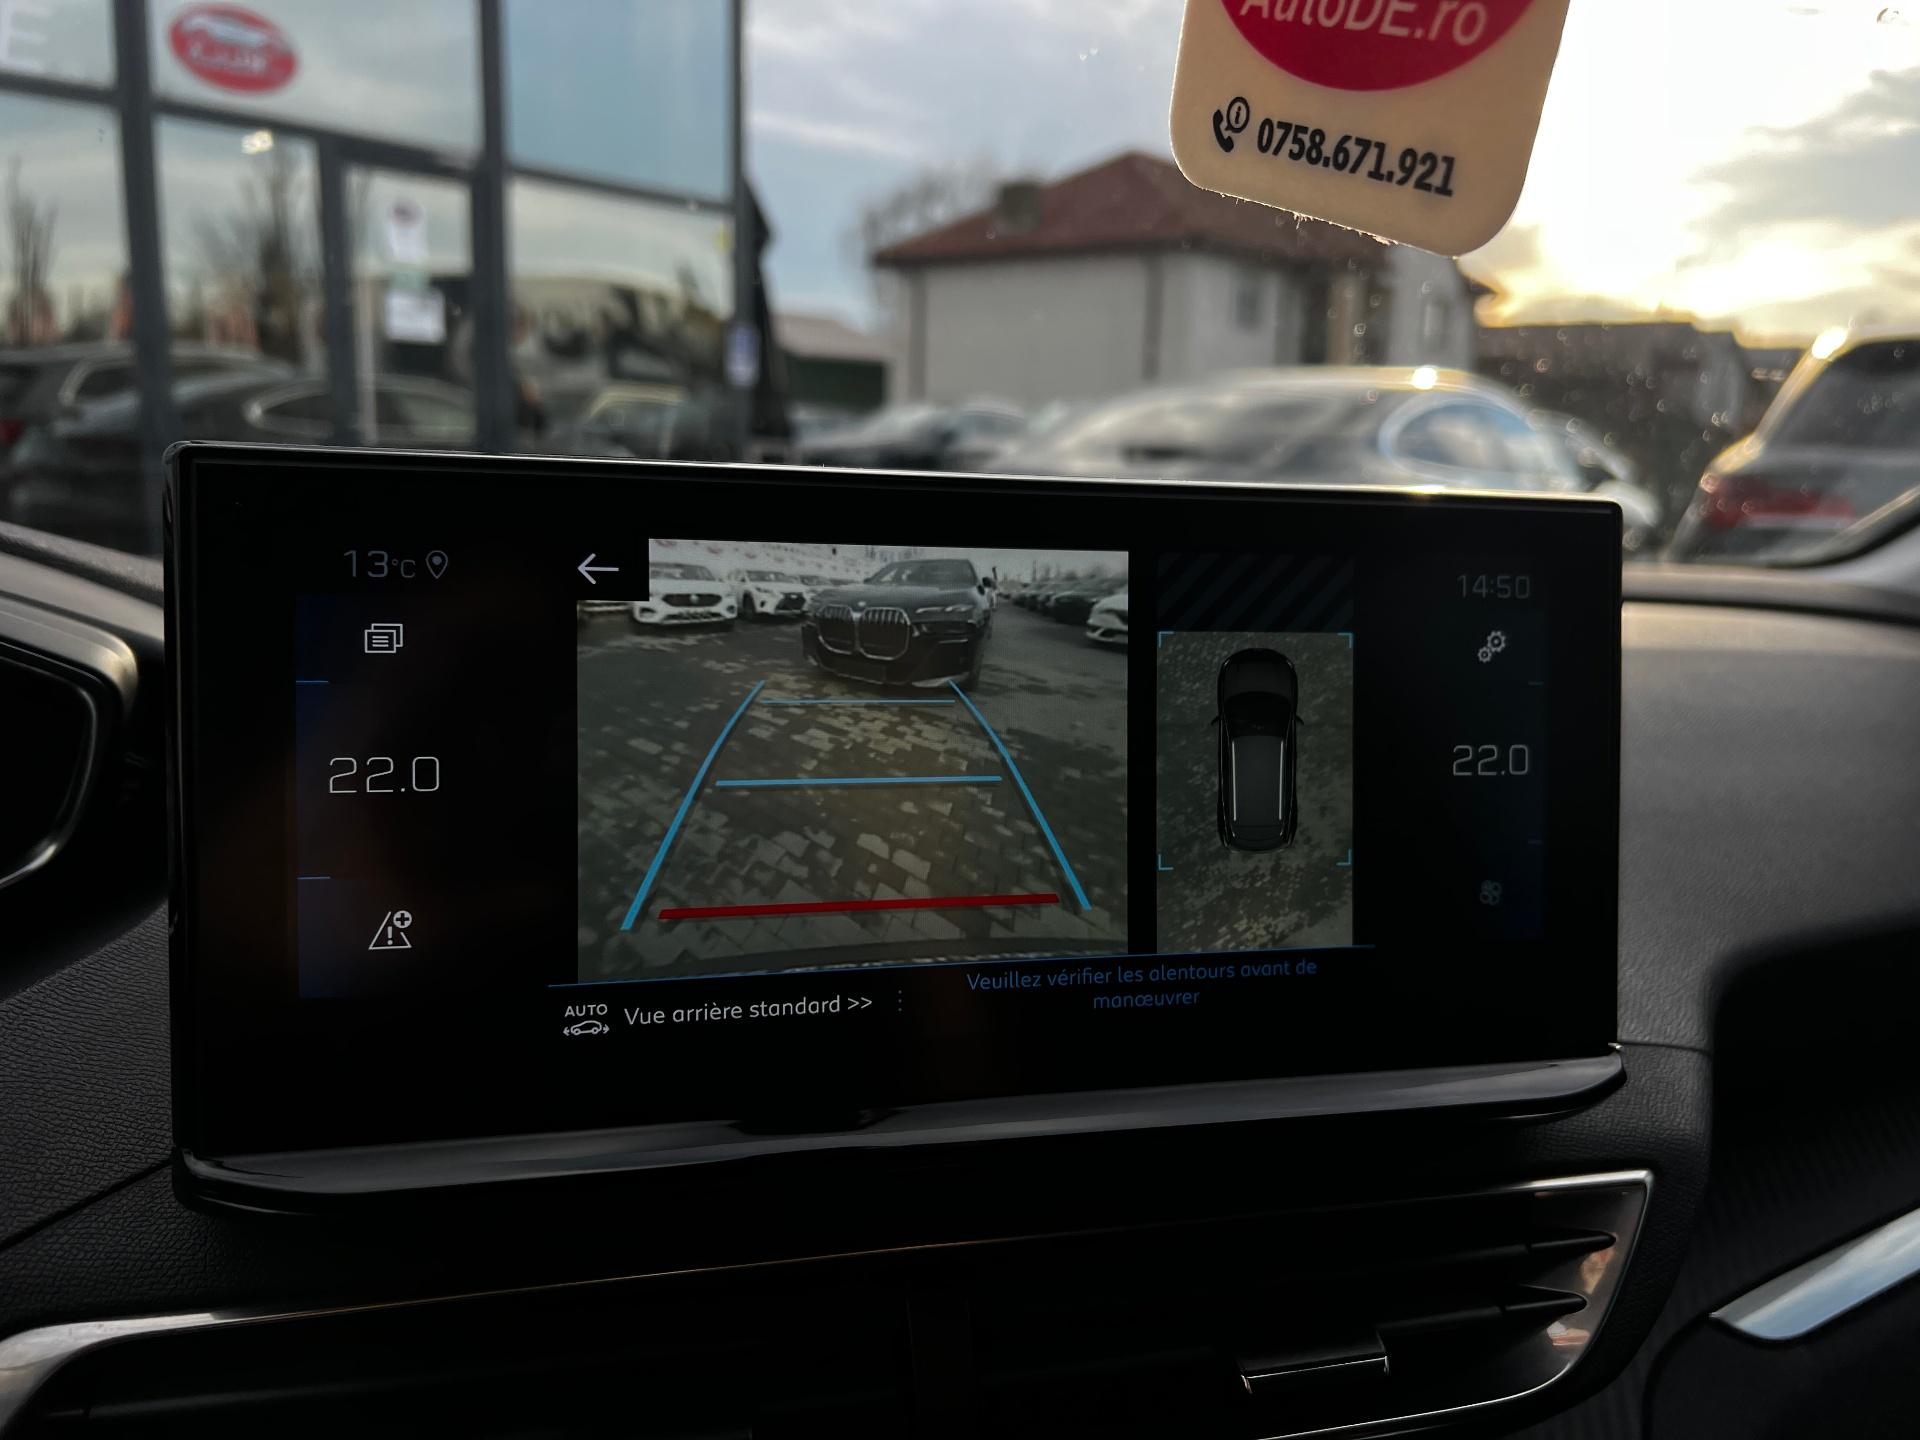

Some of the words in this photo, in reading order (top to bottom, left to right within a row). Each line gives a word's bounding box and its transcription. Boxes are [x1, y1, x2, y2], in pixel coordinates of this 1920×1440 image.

[1257, 117, 1456, 197] 0758.671.921
[1457, 574, 1531, 599] 14:50
[328, 756, 441, 794] 22.0
[1452, 744, 1530, 776] 22.0
[967, 972, 1042, 990] Veuillez
[1047, 967, 1112, 986] vérifier
[1117, 965, 1144, 983] les
[1149, 961, 1236, 982] alentours
[1240, 960, 1291, 977] avant
[1295, 958, 1318, 975] de
[564, 1003, 609, 1018] AUTO
[624, 1006, 666, 1026] Vue
[672, 1002, 743, 1023] arrière
[749, 995, 841, 1018] standard
[1093, 991, 1200, 1009] manœuvrer
